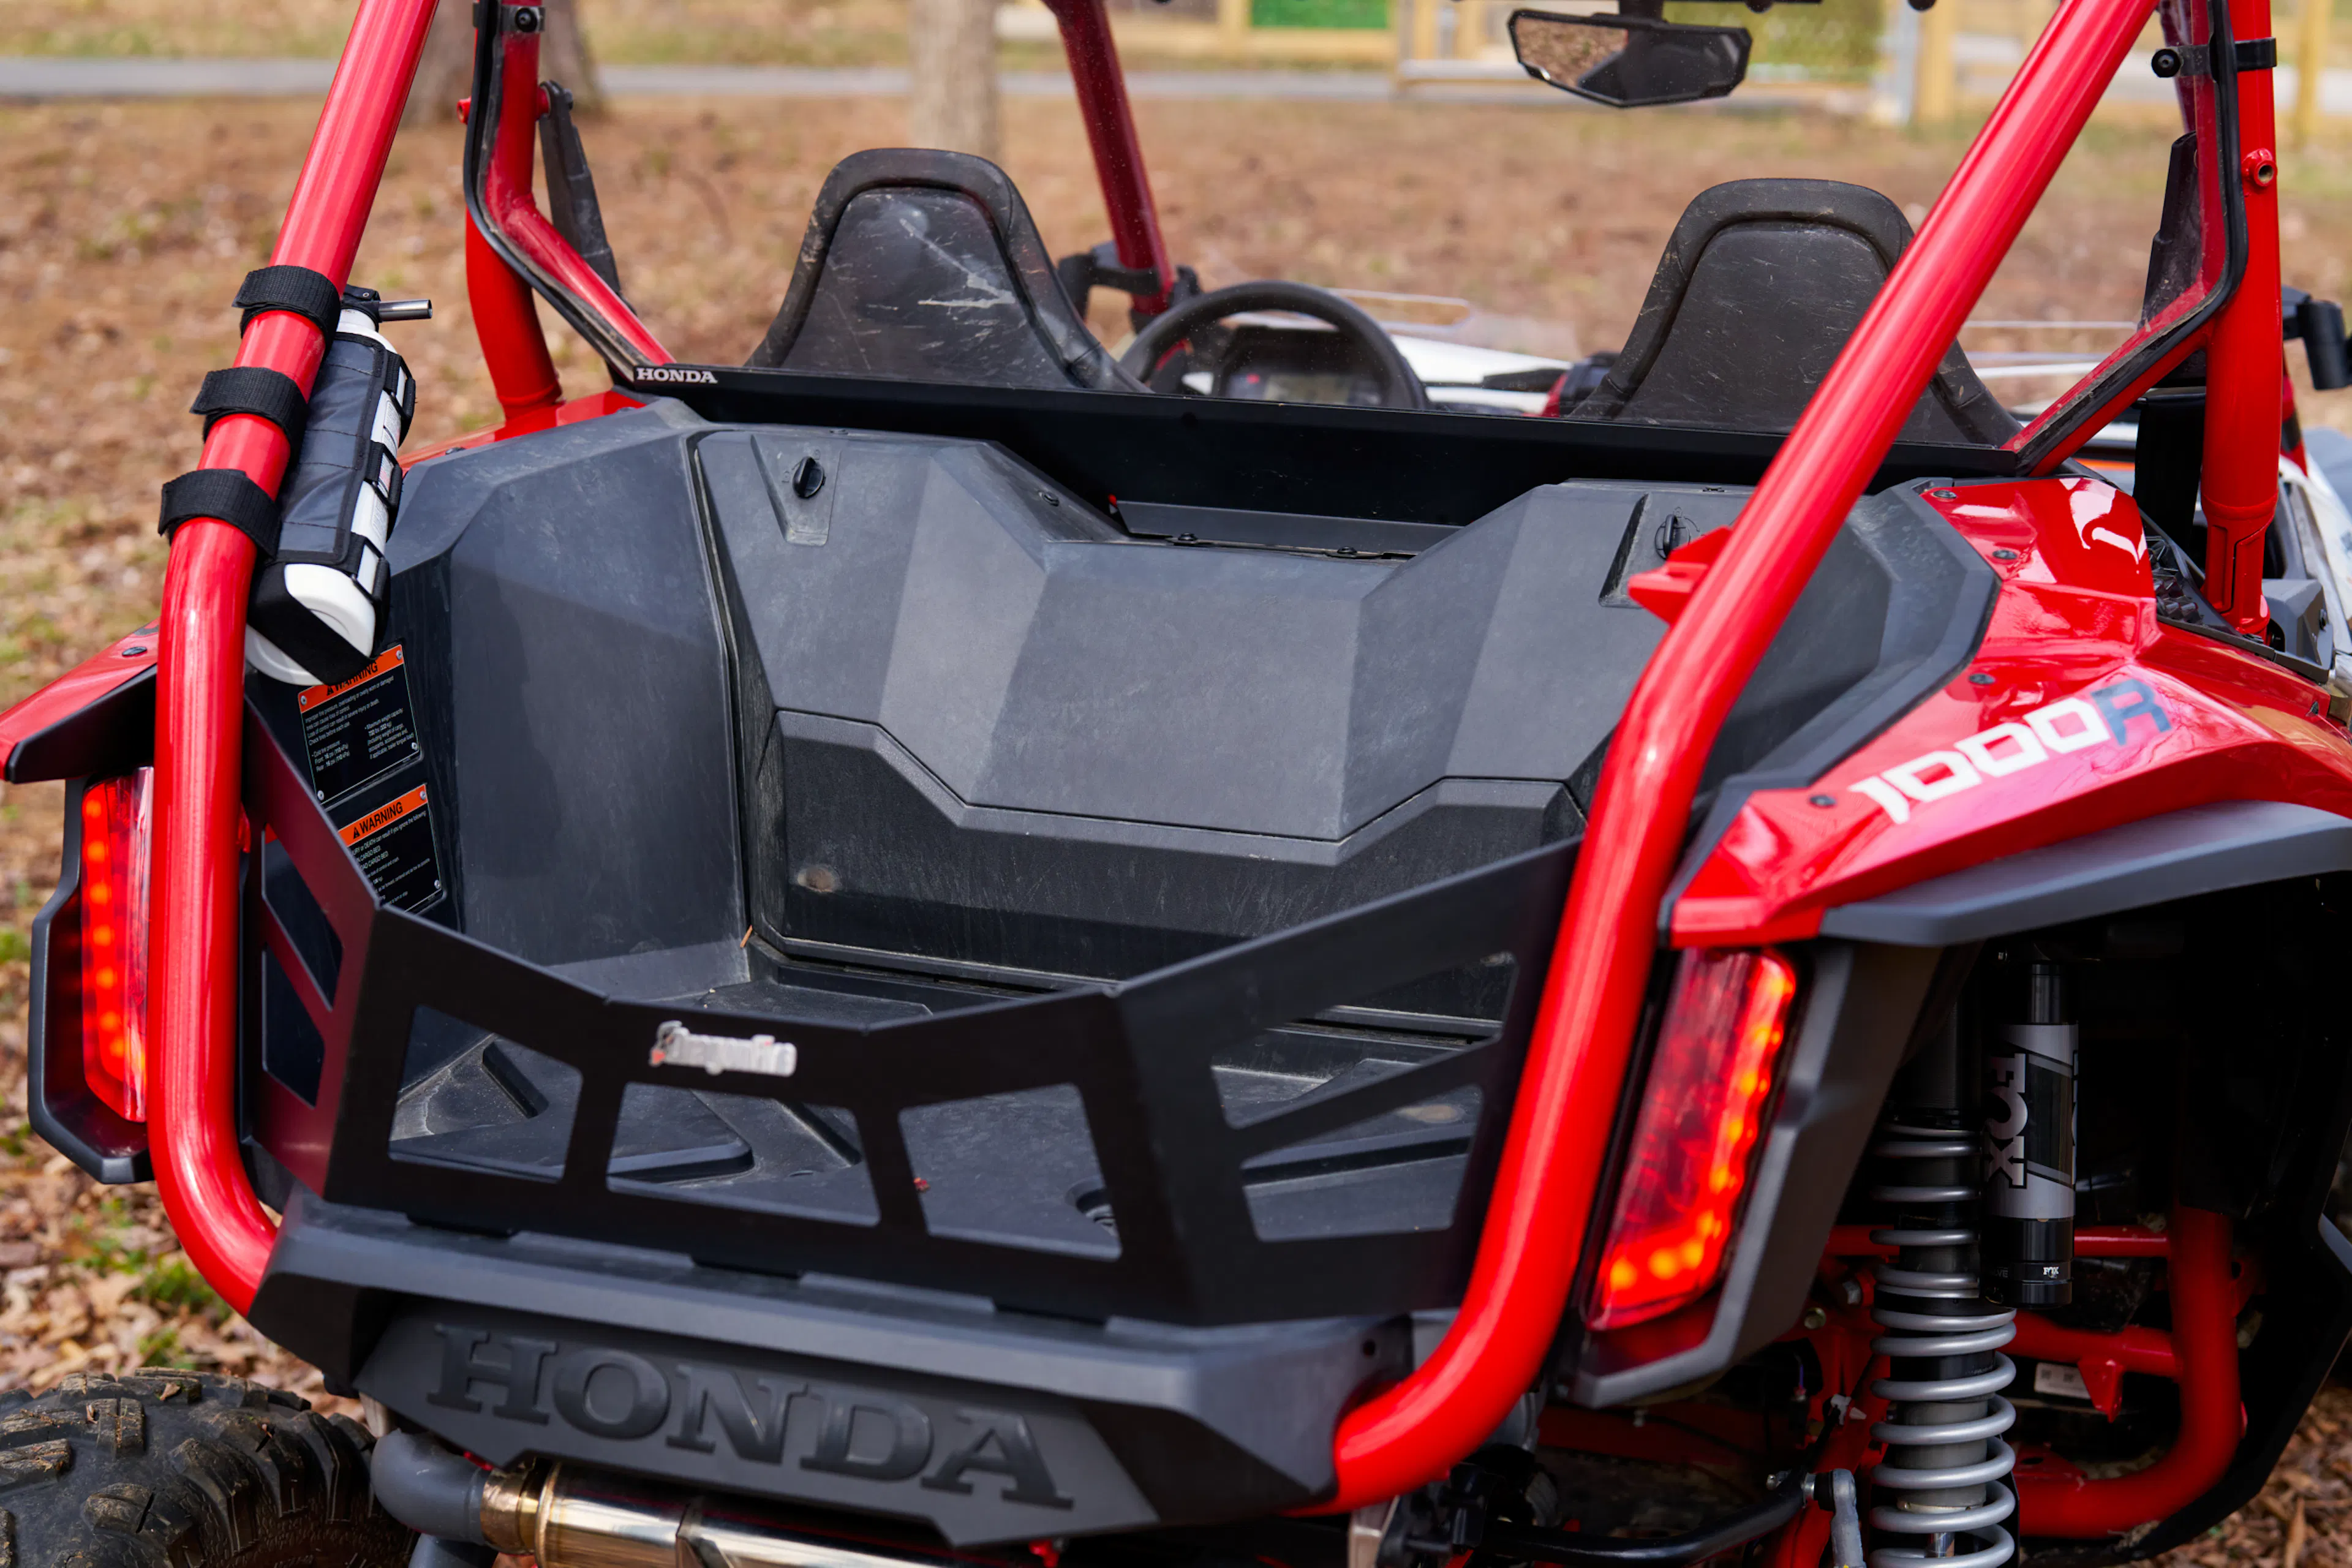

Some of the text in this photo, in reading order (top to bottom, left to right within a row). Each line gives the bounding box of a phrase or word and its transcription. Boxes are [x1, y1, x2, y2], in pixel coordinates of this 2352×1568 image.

[636, 368, 718, 384] HONDA
[1848, 678, 2173, 824] 1000R
[360, 802, 403, 834] WARNING
[1985, 1052, 2029, 1187] FOX
[2043, 1266, 2060, 1277] FOX
[426, 1322, 1076, 1511] HONDA
